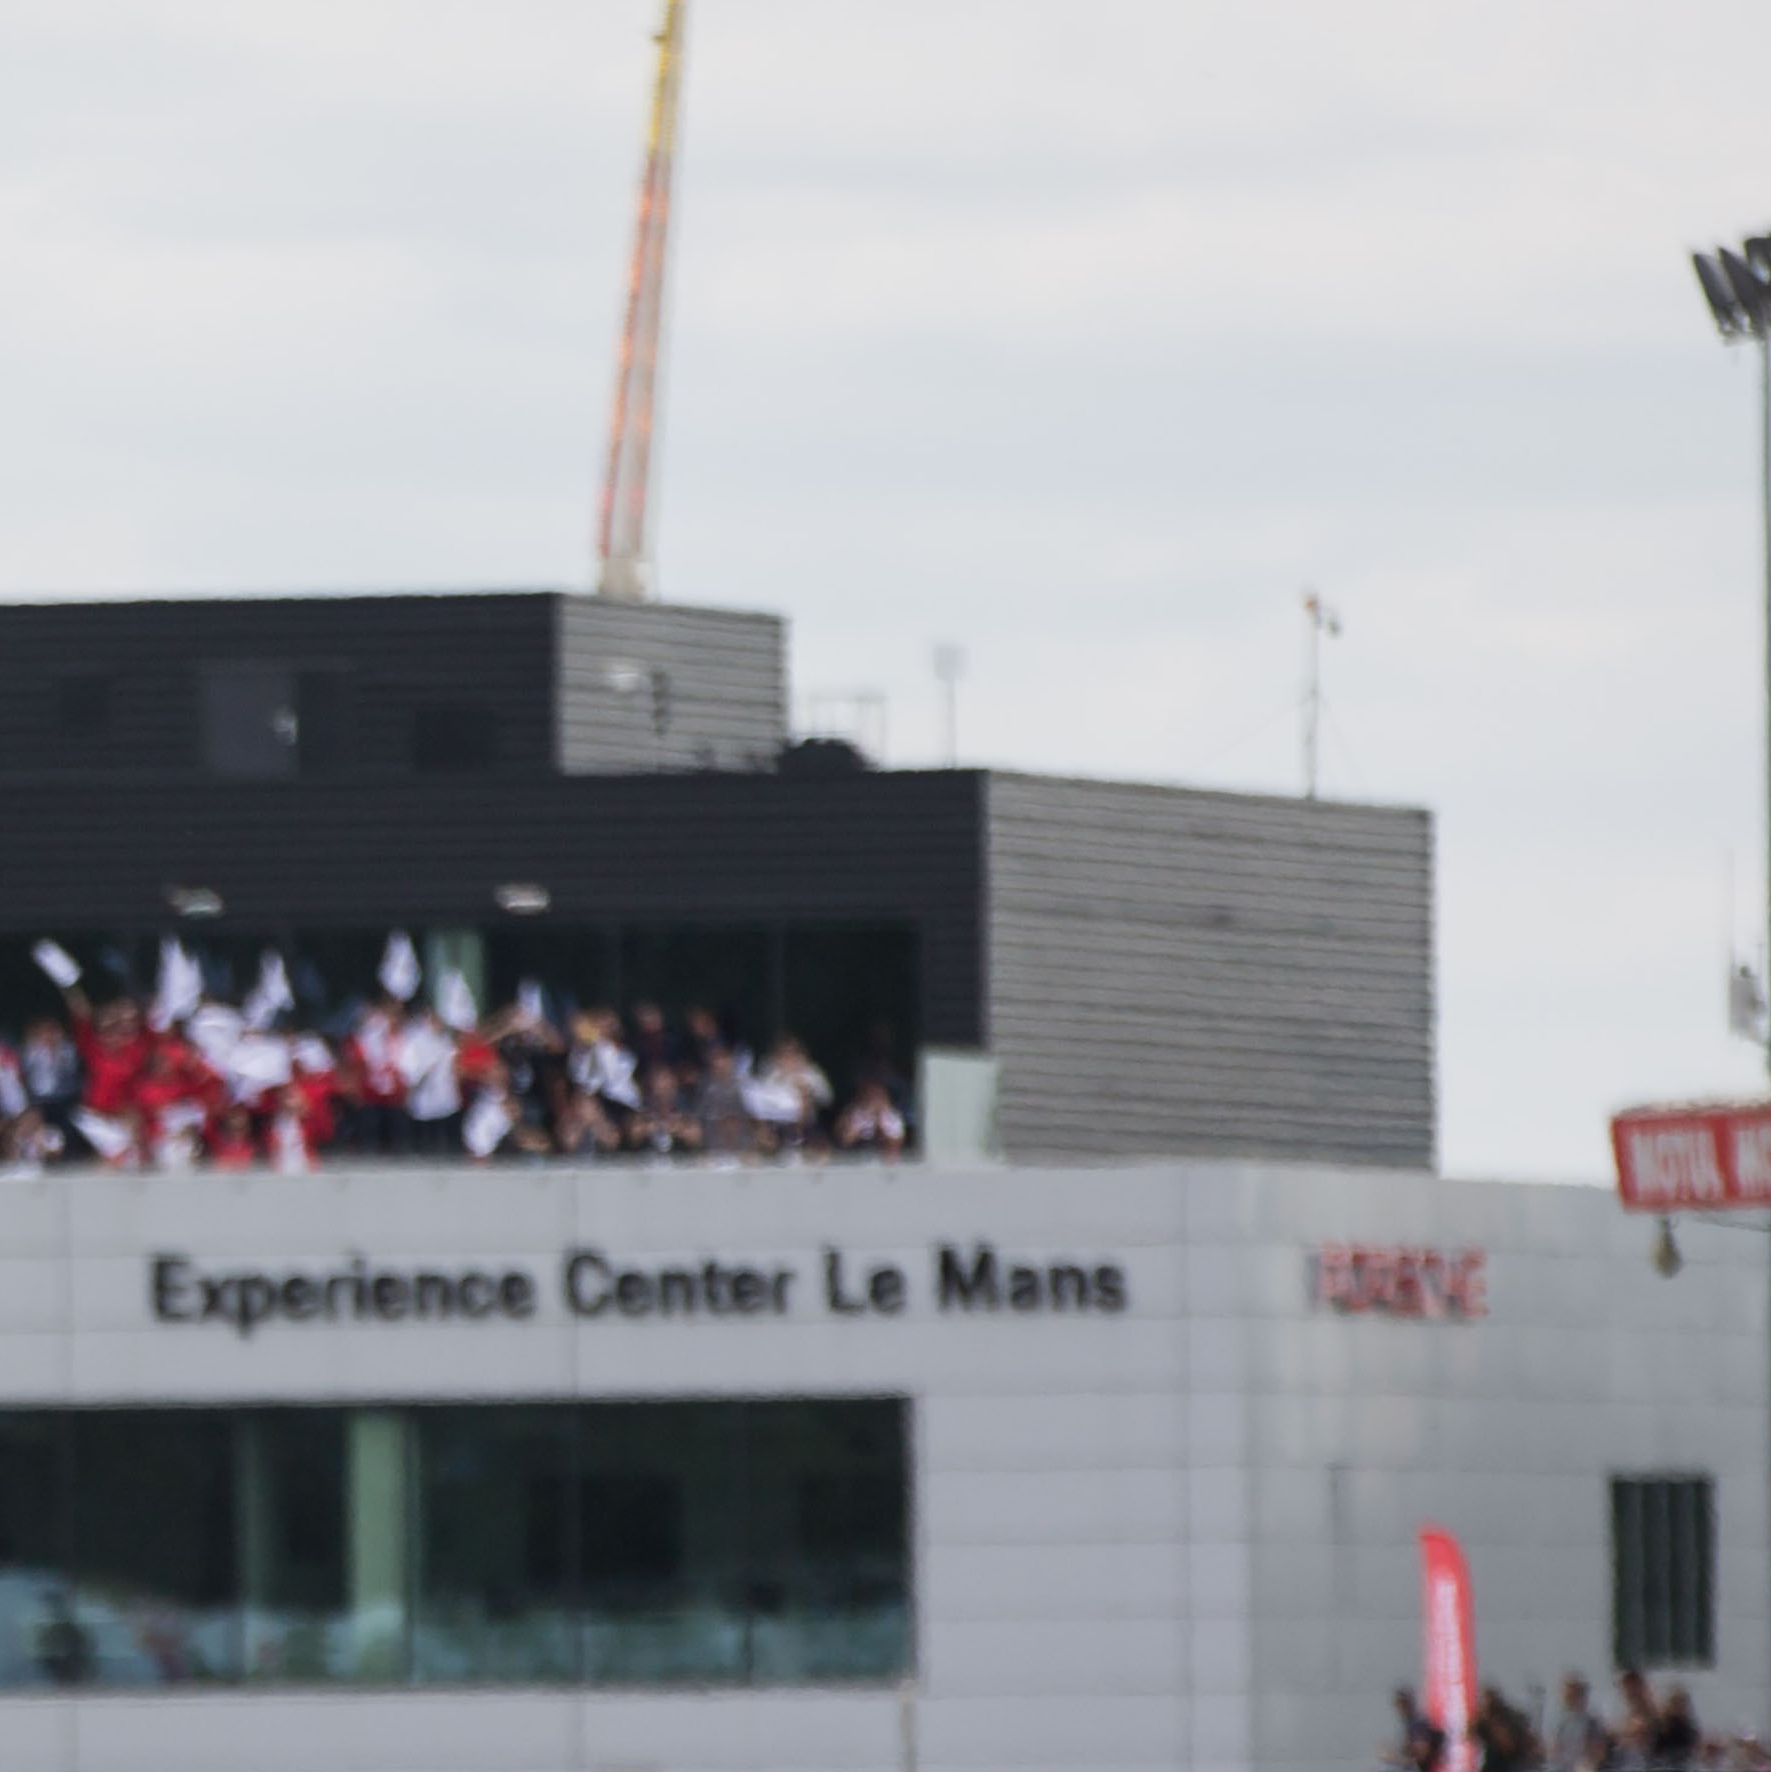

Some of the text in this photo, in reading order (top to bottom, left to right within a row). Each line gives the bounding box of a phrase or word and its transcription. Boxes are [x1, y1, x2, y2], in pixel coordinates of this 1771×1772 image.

[149, 1243, 1130, 1337] Experience Center Le Mans
